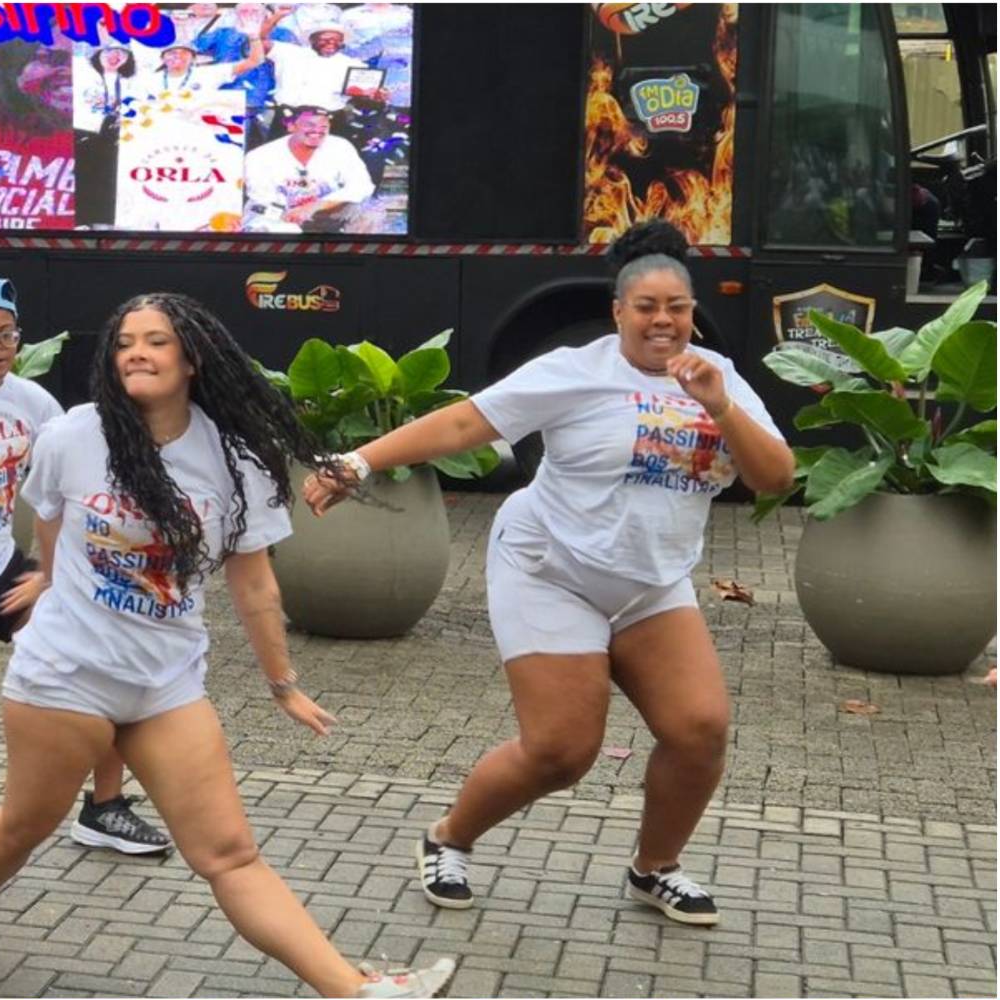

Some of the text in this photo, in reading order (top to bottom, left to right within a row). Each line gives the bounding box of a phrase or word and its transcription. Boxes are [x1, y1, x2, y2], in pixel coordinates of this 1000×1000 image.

[660, 82, 694, 109] Dia
[130, 166, 226, 183] ORLA
[246, 271, 323, 311] FIREBUS
[86, 513, 110, 536] NO
